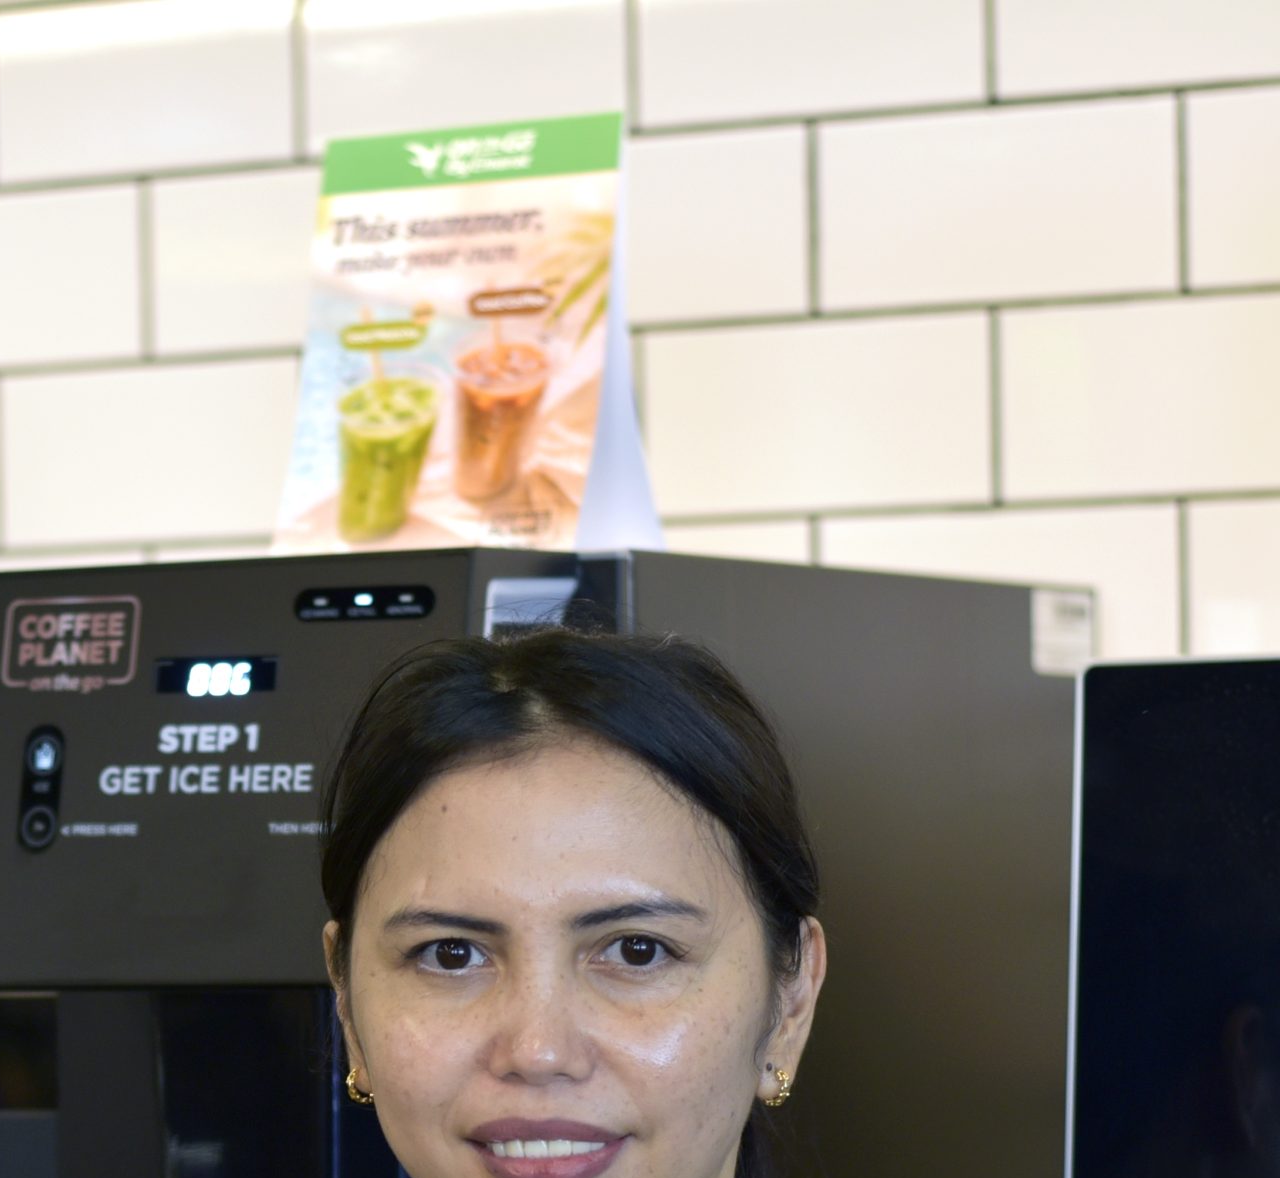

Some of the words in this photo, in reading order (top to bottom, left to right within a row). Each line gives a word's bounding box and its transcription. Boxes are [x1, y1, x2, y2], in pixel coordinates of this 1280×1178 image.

[19, 612, 126, 640] COFFEE
[18, 640, 125, 667] PLANET
[158, 724, 239, 754] STEP
[244, 723, 260, 752] 1
[98, 766, 162, 795] GET
[169, 765, 220, 793] ICE
[228, 763, 314, 793] HERE
[72, 823, 106, 836] PRESS
[108, 823, 139, 837] HERE
